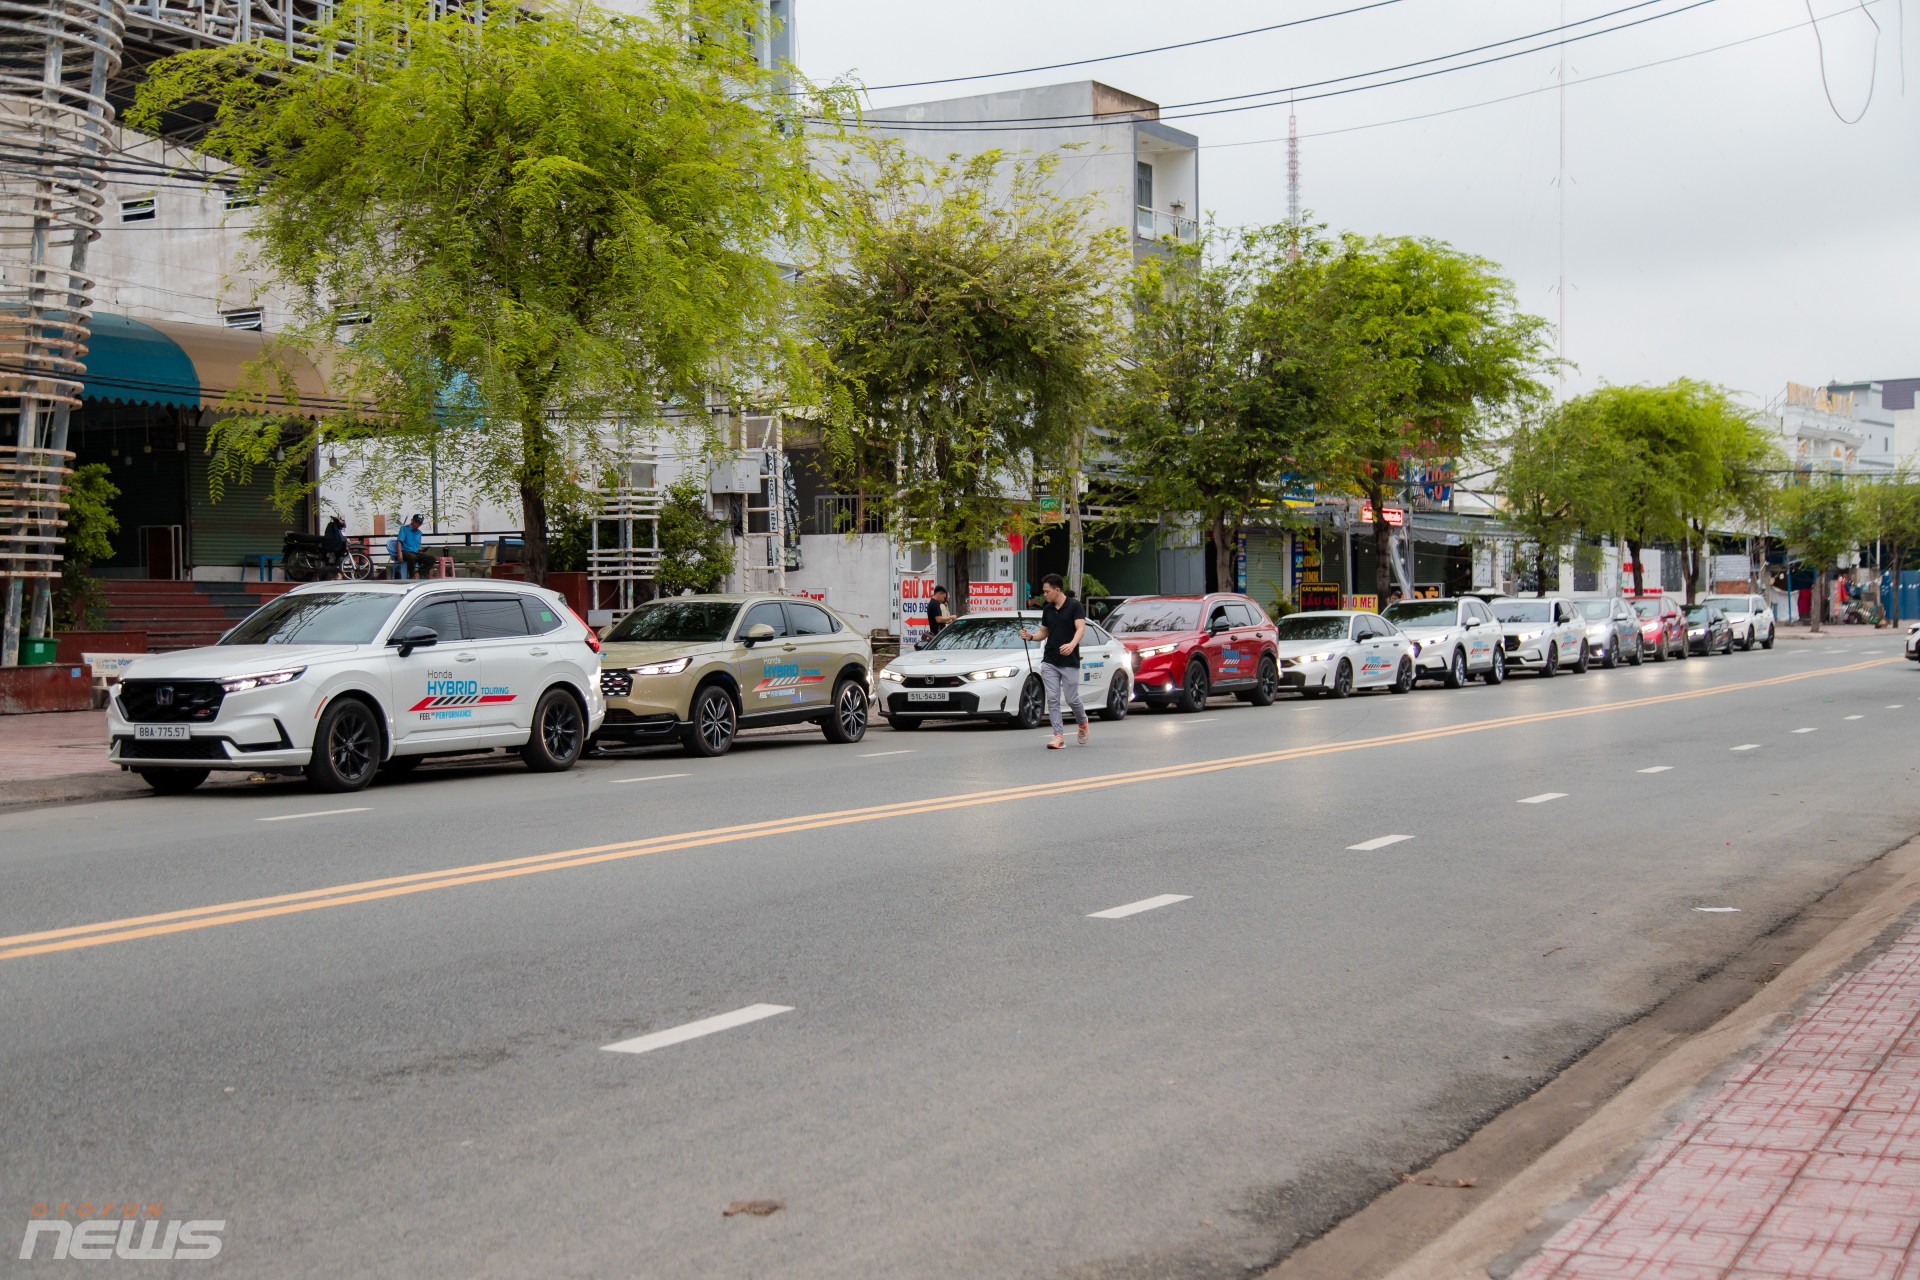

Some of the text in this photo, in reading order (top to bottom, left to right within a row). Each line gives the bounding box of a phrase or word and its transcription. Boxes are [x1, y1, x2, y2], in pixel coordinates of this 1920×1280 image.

[902, 575, 935, 599] GIỮ XE
[984, 585, 998, 593] Hair
[999, 585, 1011, 595] Spa
[919, 600, 929, 613] ĐÊ
[1342, 596, 1357, 608] HO
[763, 656, 781, 664] Honda
[427, 669, 453, 679] Honda
[763, 663, 799, 678] HYBRID
[427, 680, 510, 696] HYBRID TOURING
[419, 712, 431, 720] FEEL
[435, 710, 472, 719] PERFORMANCE
[139, 727, 185, 737] 88A-775.57
